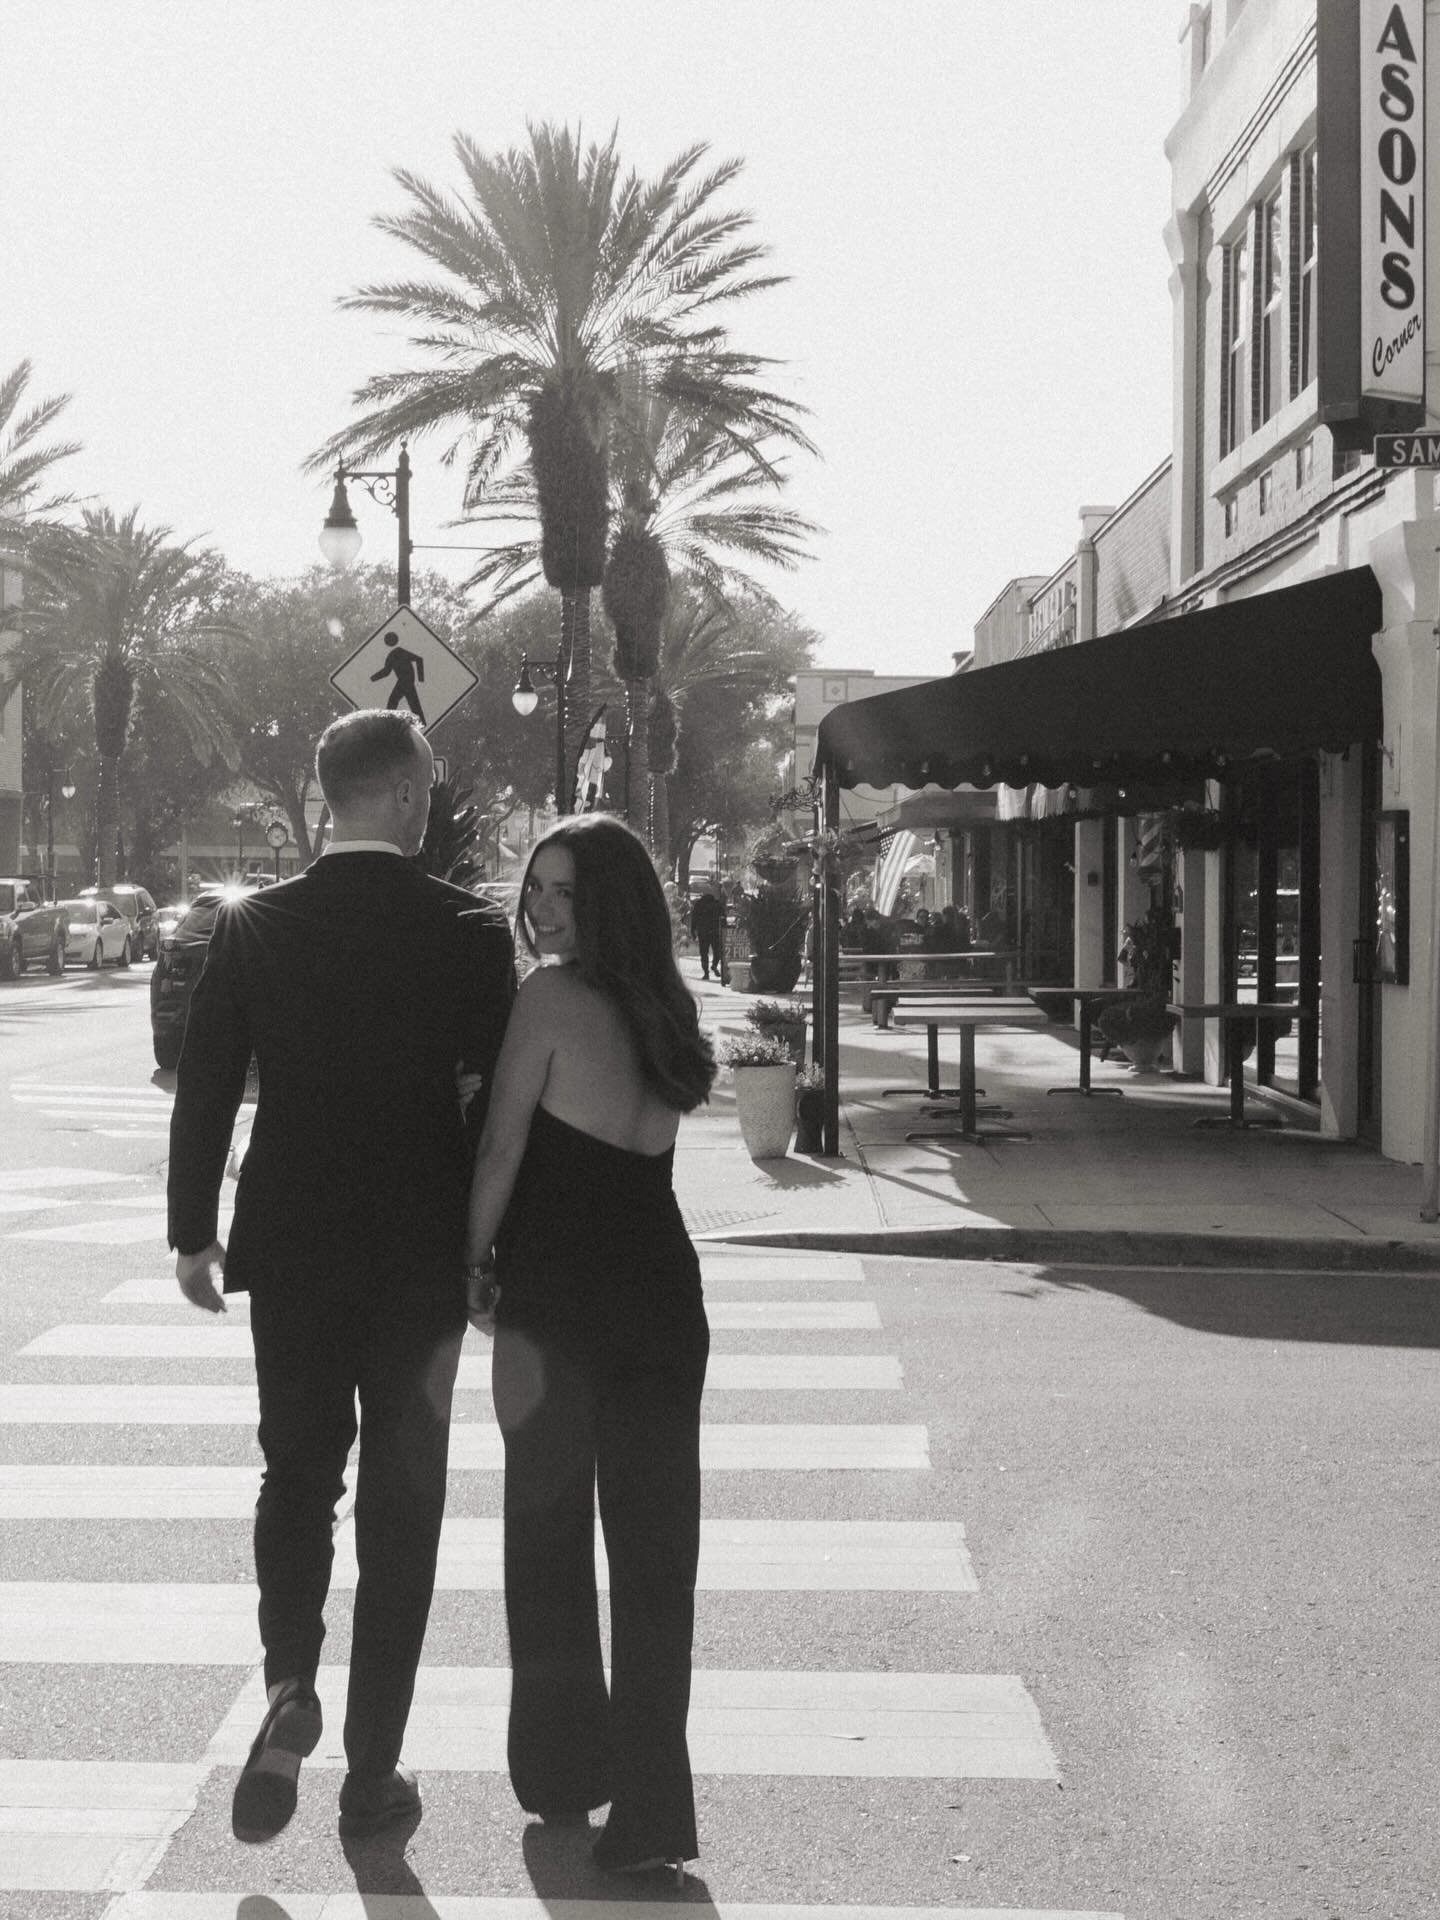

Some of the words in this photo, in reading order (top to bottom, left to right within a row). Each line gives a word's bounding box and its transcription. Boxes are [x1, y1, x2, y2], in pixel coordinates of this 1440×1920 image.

[1376, 3, 1417, 311] ASONS
[1373, 314, 1421, 377] Corner
[1392, 438, 1440, 464] SAM
